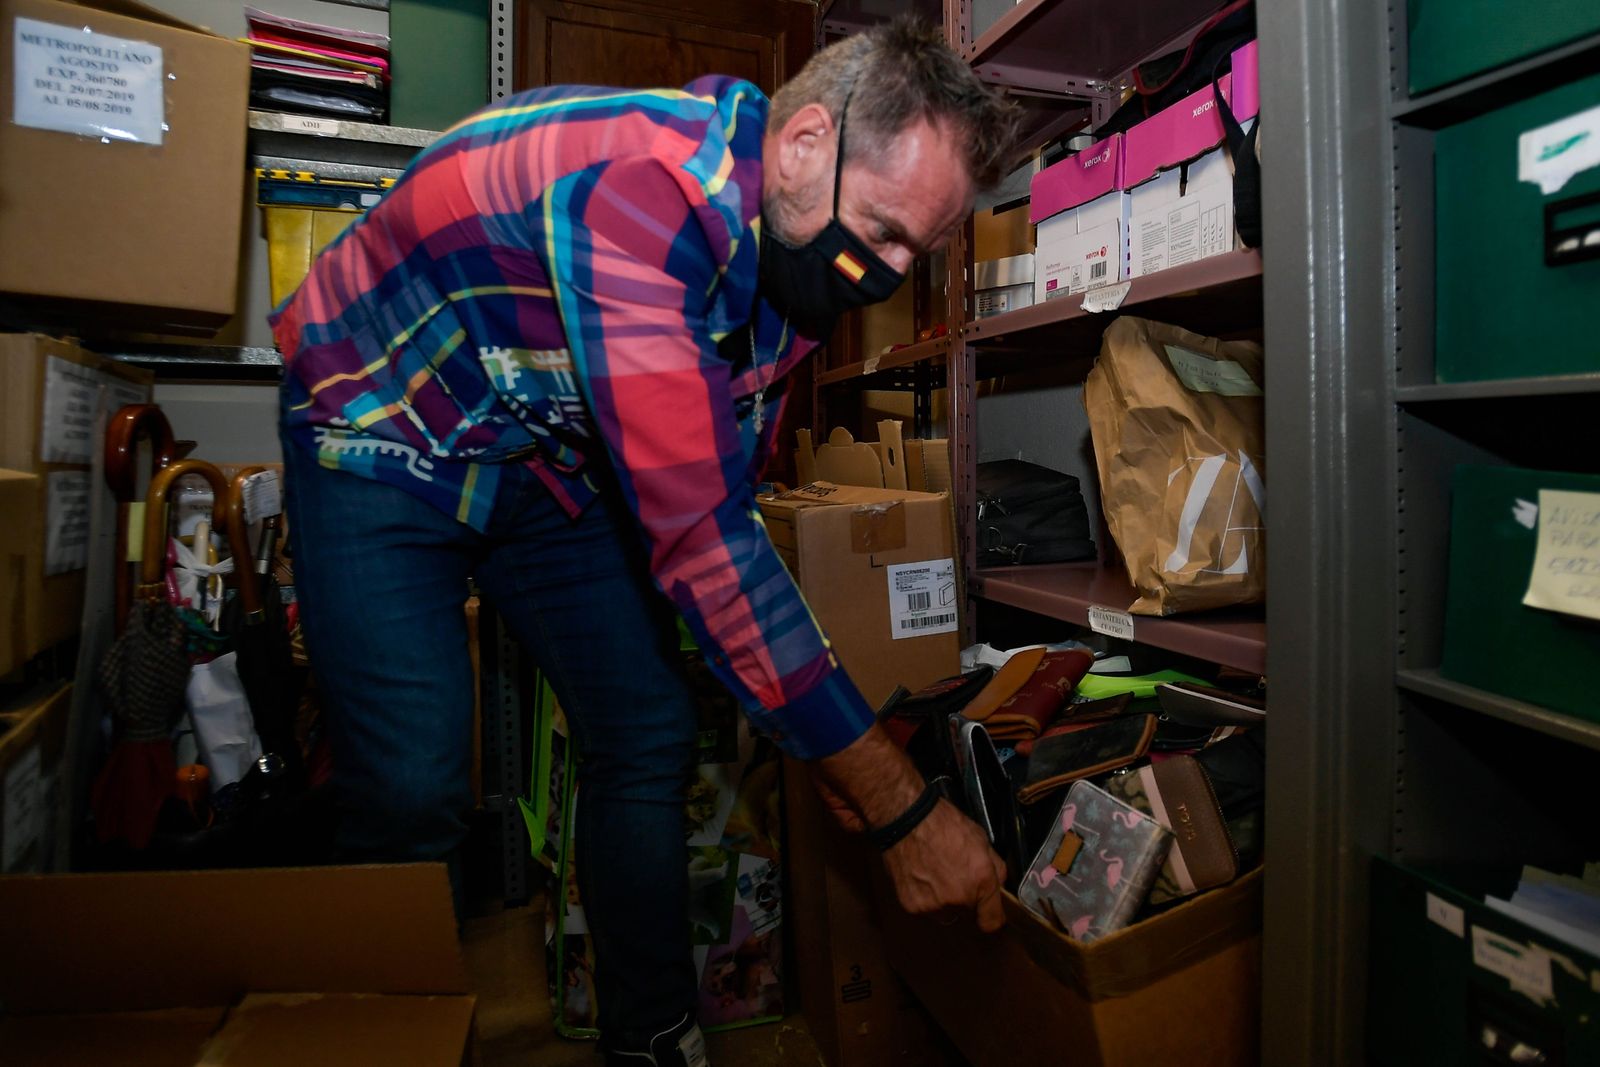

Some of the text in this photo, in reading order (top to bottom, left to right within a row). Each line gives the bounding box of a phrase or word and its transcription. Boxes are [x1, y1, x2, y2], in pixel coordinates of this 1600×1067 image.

[20, 33, 153, 65] METROPOLITANO
[57, 54, 120, 73] AGOSTO
[47, 66, 80, 81] EXP.
[34, 79, 63, 91] DEL
[42, 95, 59, 105] AL
[1192, 99, 1214, 118] xerox
[1083, 155, 1102, 169] xerox
[1086, 251, 1099, 260] xerox
[850, 965, 862, 981] 3
